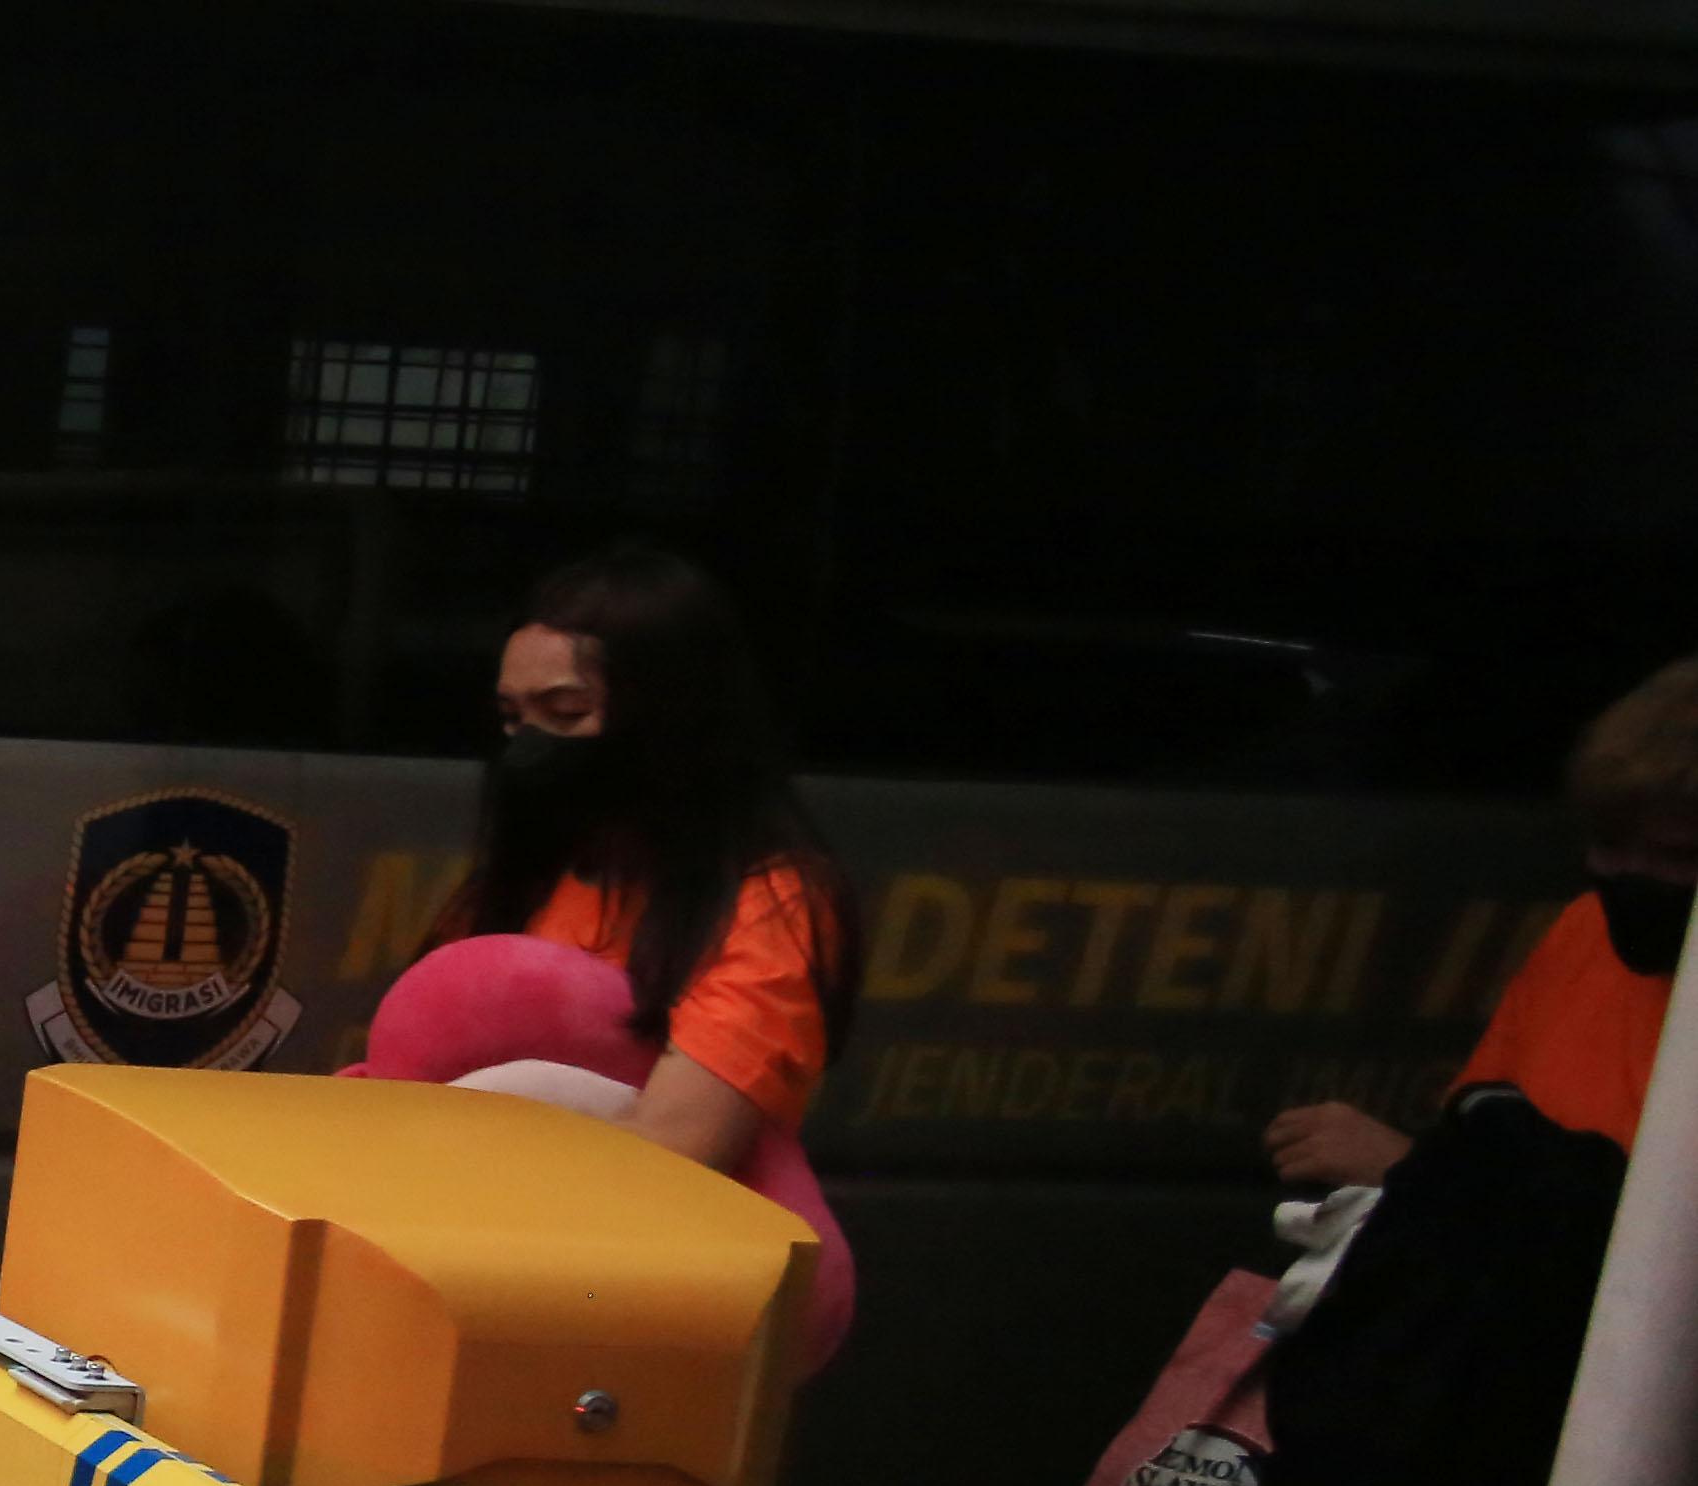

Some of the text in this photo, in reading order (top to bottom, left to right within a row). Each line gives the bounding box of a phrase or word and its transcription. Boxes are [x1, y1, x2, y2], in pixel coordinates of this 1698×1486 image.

[861, 871, 1385, 1013] DETENI
[111, 976, 224, 1015] IMIGRASI
[851, 1041, 1246, 1128] JENDERAL
